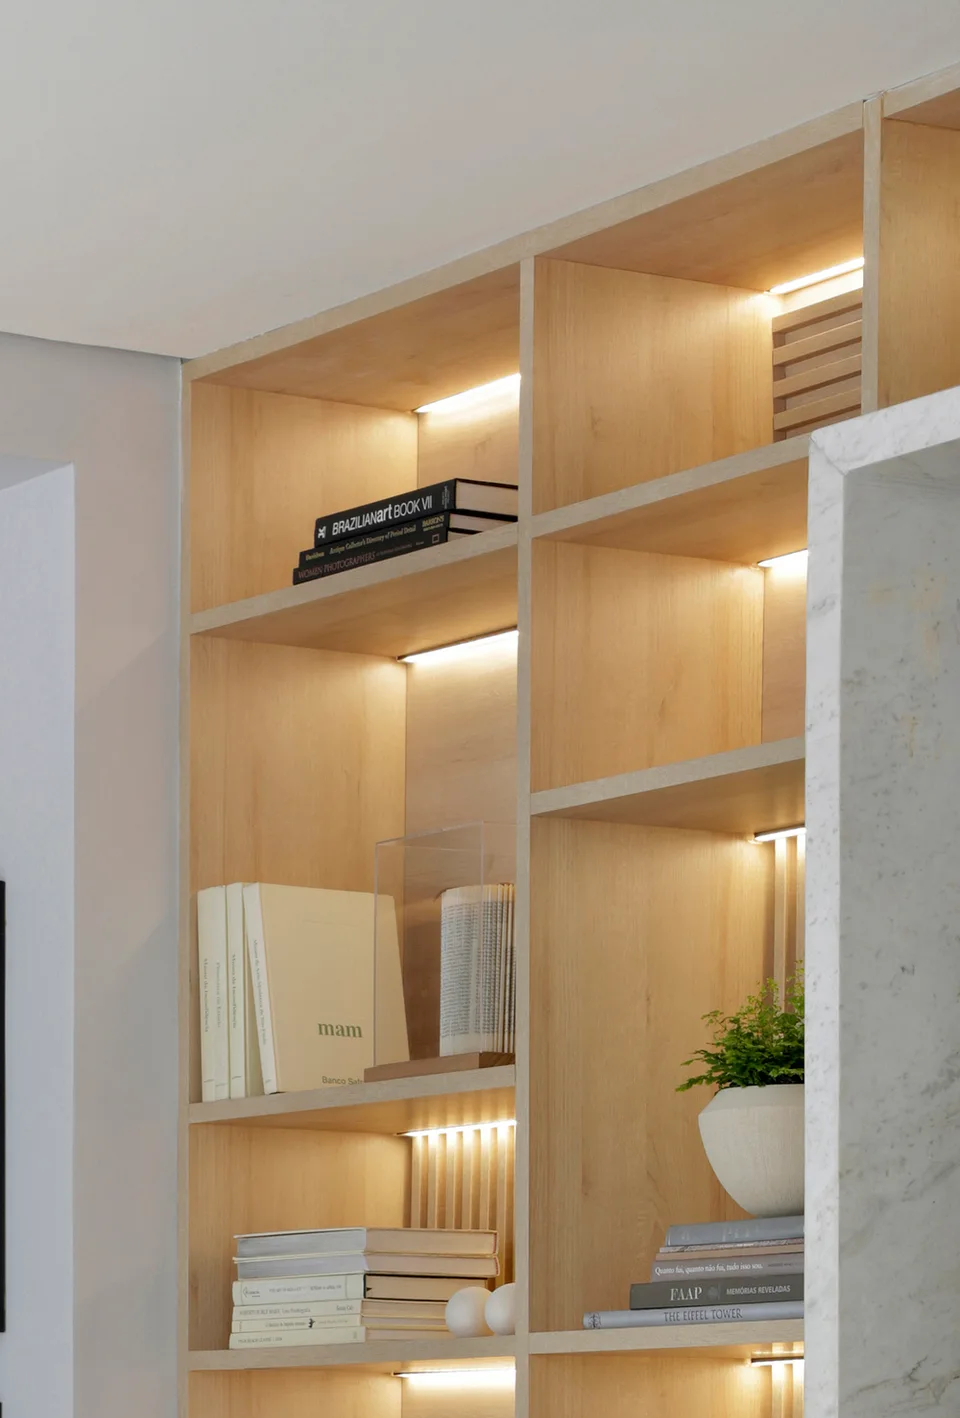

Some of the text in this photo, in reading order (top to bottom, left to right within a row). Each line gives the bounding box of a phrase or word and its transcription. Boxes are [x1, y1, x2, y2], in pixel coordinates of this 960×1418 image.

[394, 499, 420, 519] BOOK
[421, 494, 433, 511] VII
[390, 528, 403, 538] Period
[298, 551, 376, 579] WOMEN PHOTOGRAPHERS
[318, 1022, 363, 1038] mam
[322, 1076, 346, 1086] Banco
[654, 1266, 674, 1276] Quanto
[675, 1264, 684, 1274] fui,
[685, 1264, 704, 1275] quanto
[704, 1263, 716, 1272] não
[716, 1262, 726, 1272] fui,
[726, 1262, 740, 1272] tudo
[740, 1262, 751, 1270] isso
[752, 1262, 764, 1270] sou.
[670, 1286, 702, 1301] FAAP
[726, 1284, 791, 1296] MEMÓRIAS REVELADAS
[664, 1308, 743, 1322] THE EIFFEL TOWER
